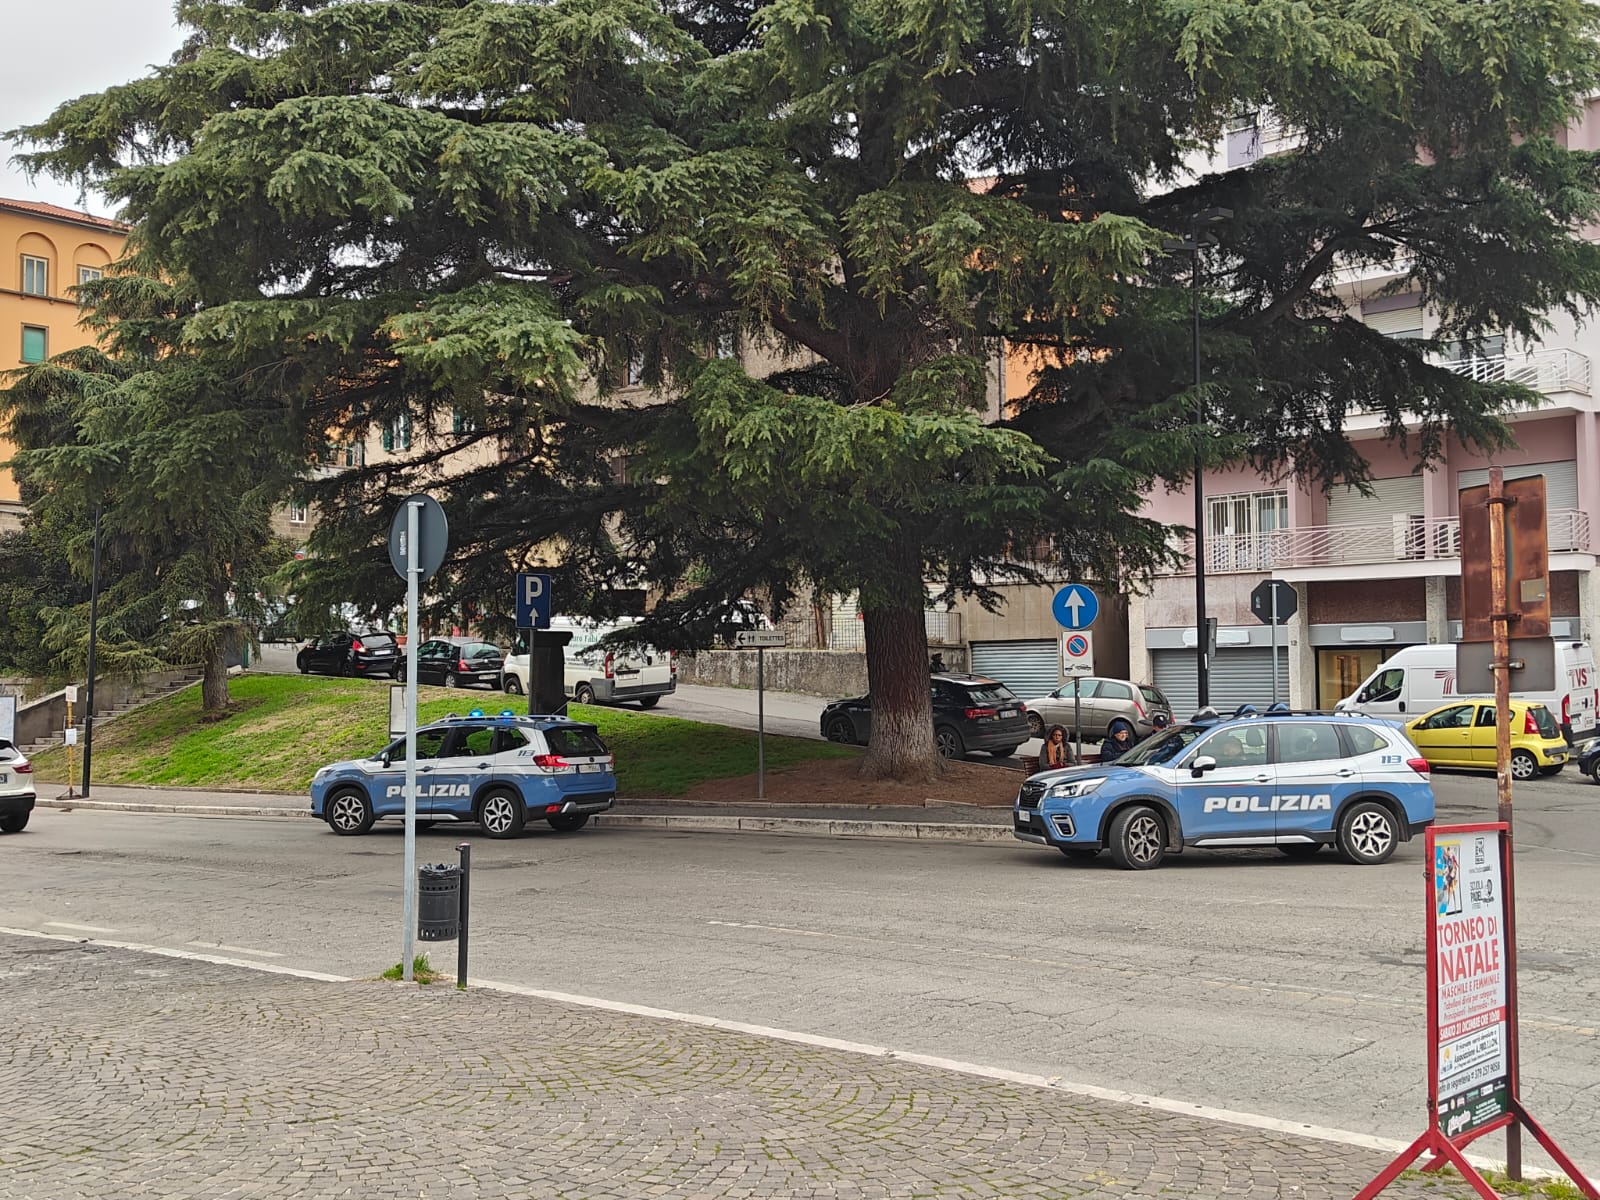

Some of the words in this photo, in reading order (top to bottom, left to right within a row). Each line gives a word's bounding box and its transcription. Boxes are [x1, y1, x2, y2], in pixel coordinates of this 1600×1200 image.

[525, 576, 543, 606] P
[1380, 755, 1402, 764] 113
[1203, 794, 1332, 813] POLIZIA
[1437, 916, 1485, 948] TORNEO
[1487, 916, 1498, 937] DI
[1440, 938, 1500, 985] NATALE
[1441, 982, 1468, 1000] MASCHILE
[1474, 973, 1500, 990] FEMMINILE
